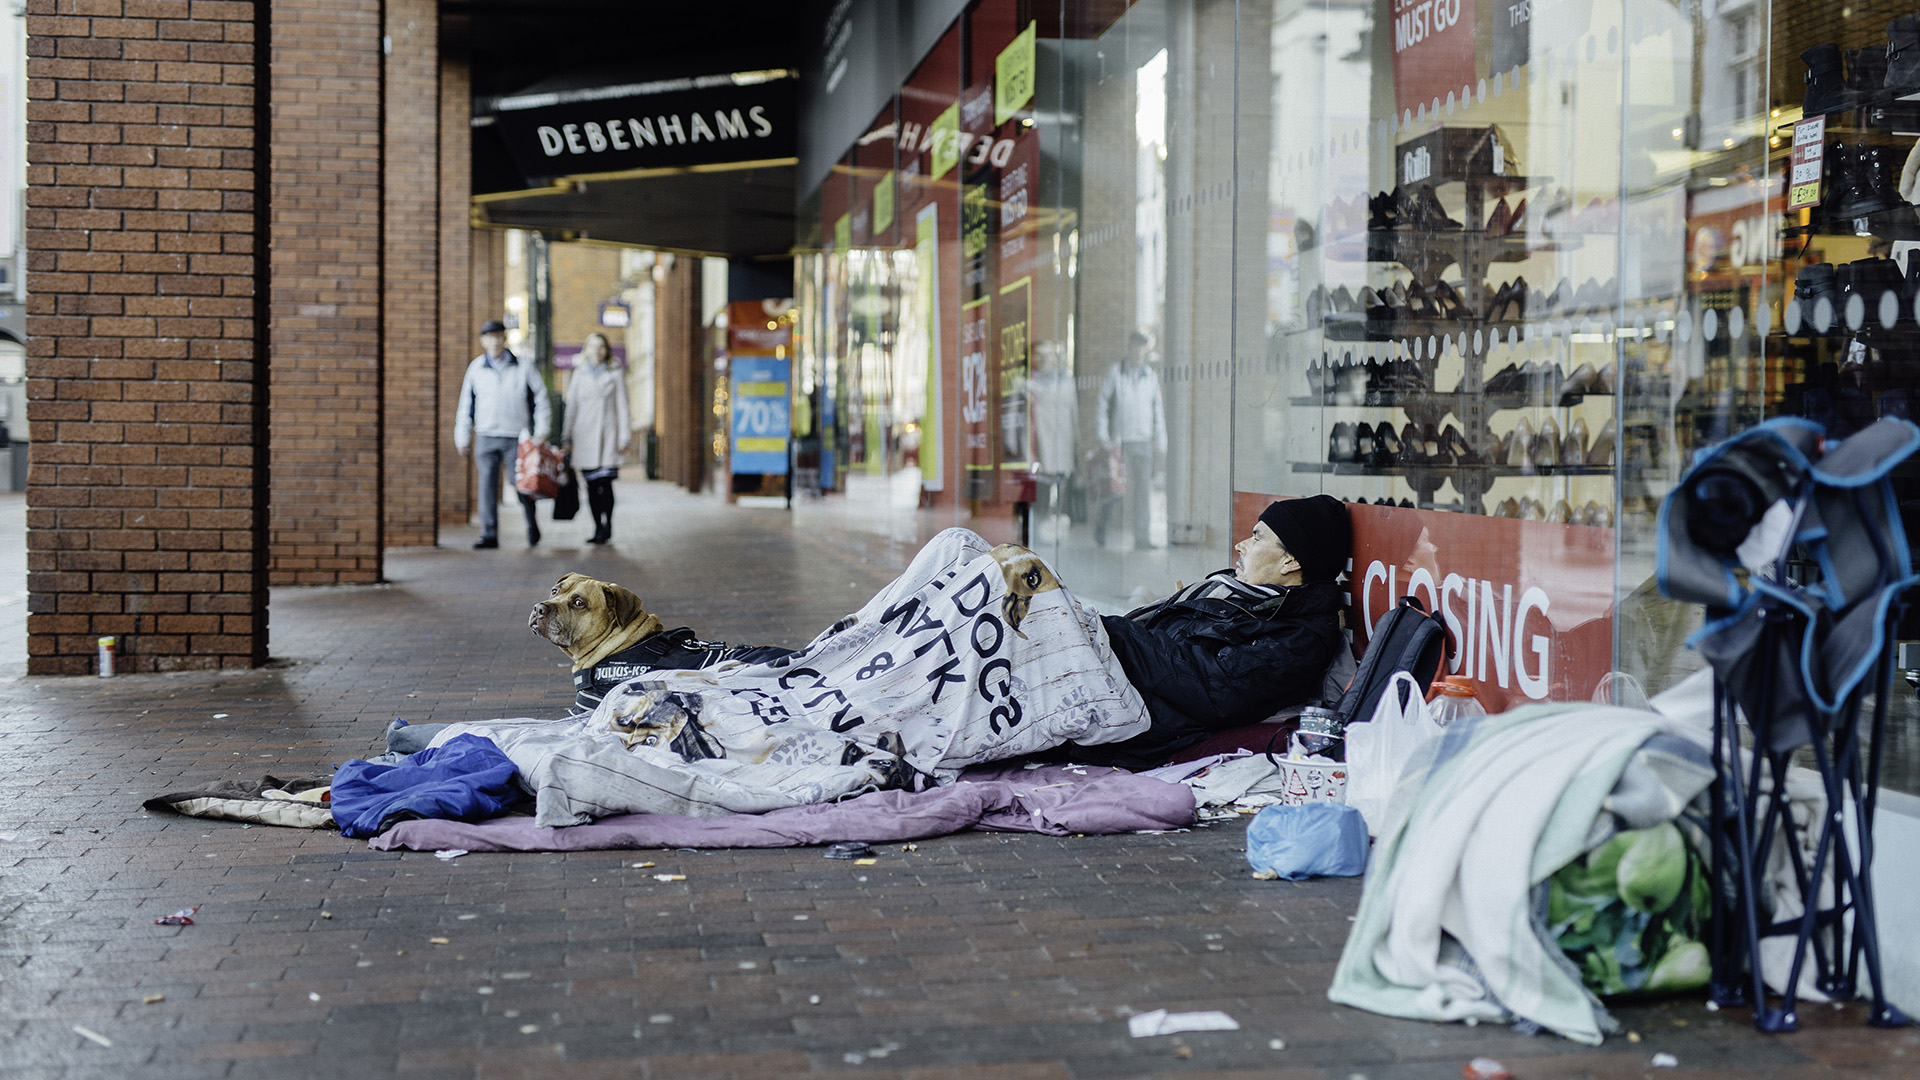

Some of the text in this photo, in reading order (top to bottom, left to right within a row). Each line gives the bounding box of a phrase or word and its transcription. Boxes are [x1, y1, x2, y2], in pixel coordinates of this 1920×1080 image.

[1395, 0, 1460, 53] MUST GO
[1508, 0, 1531, 27] THIS
[537, 106, 772, 157] DEBENHAMS
